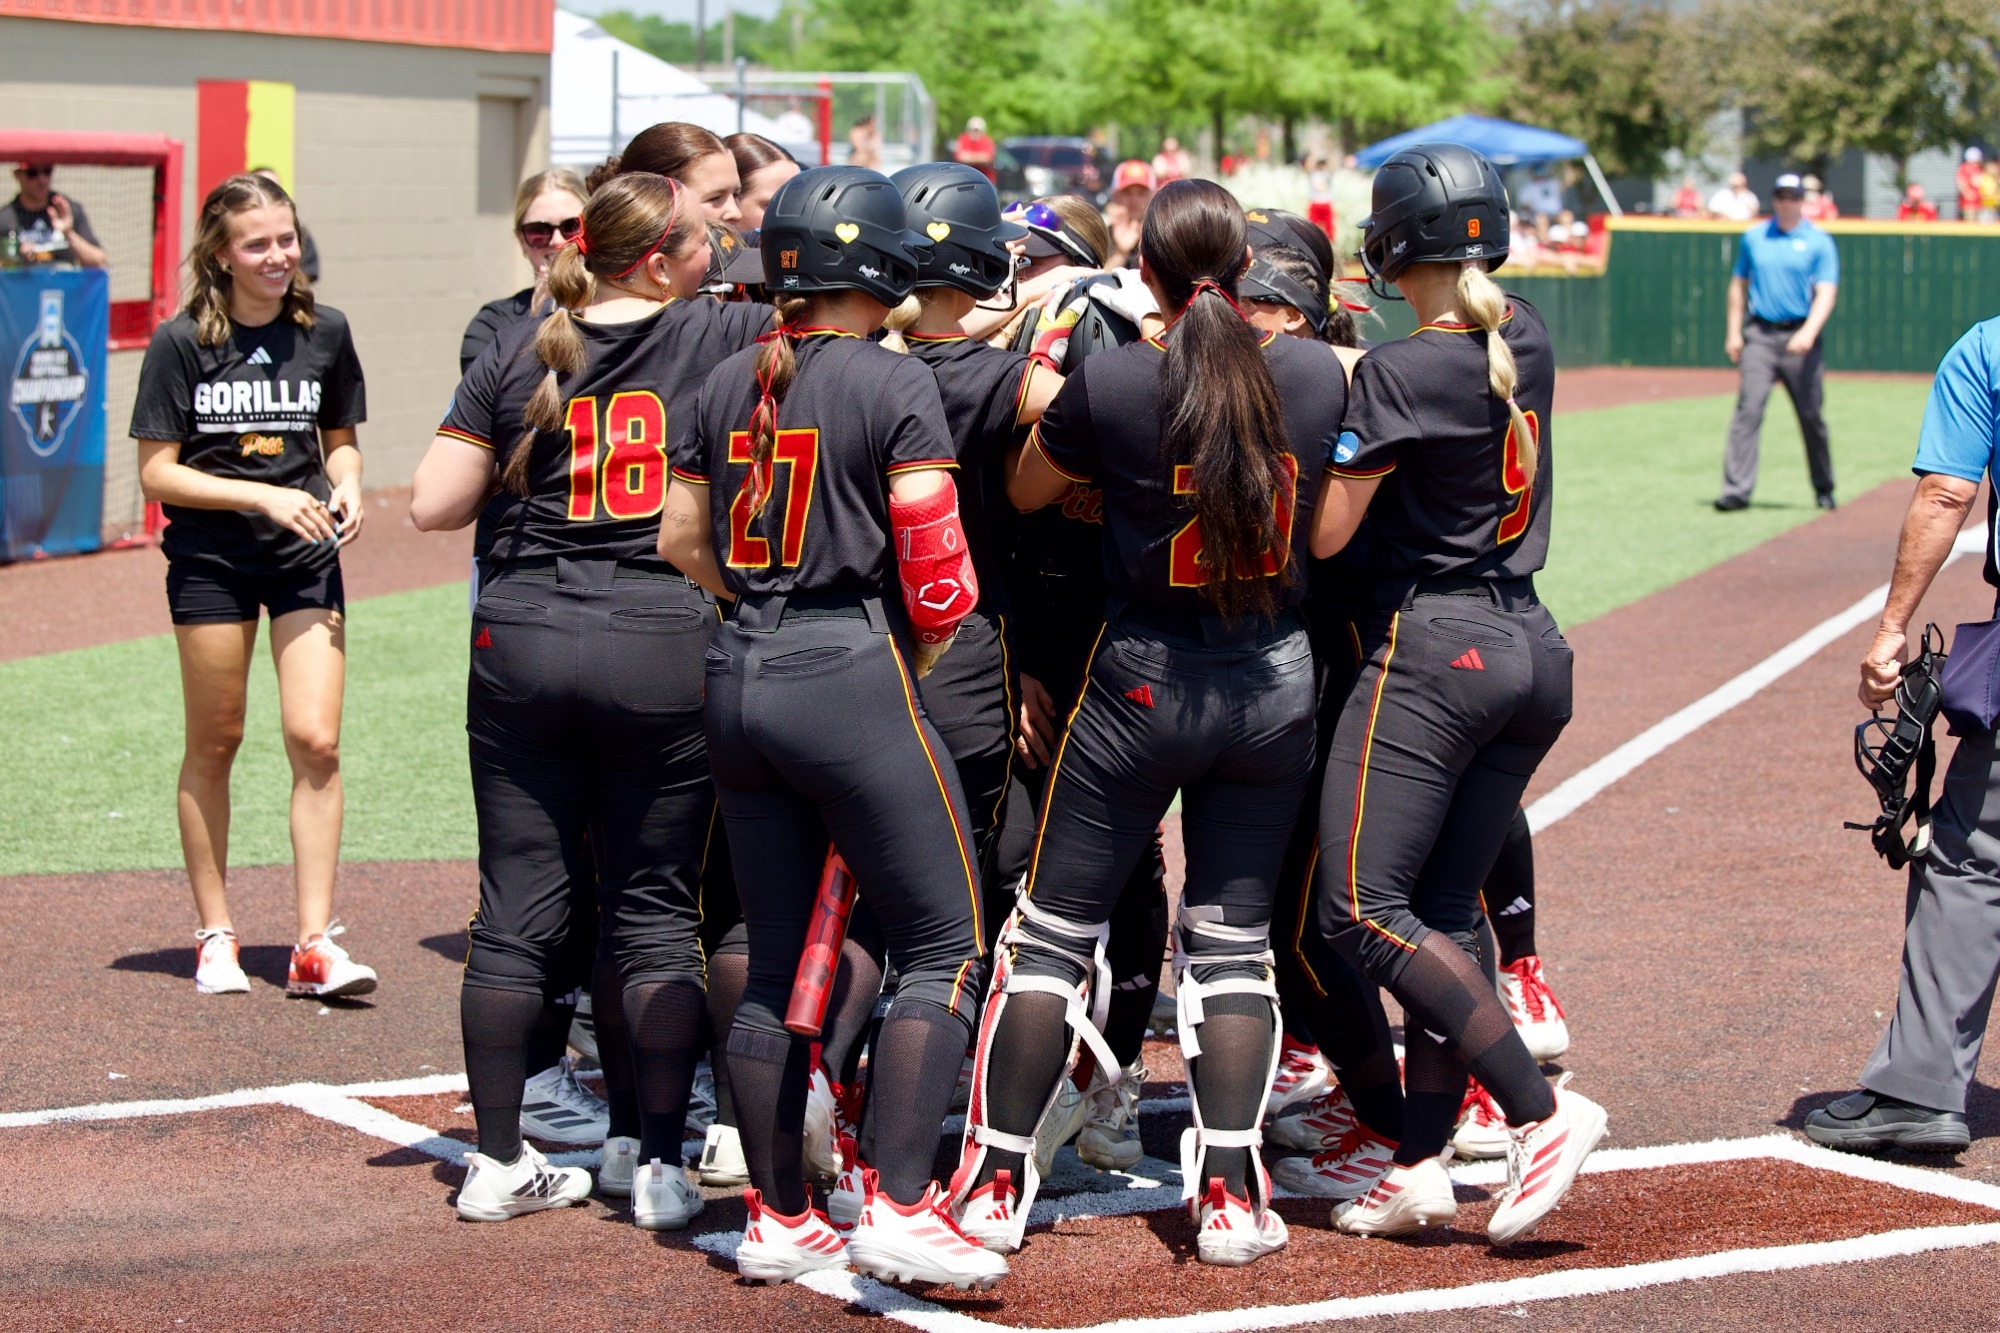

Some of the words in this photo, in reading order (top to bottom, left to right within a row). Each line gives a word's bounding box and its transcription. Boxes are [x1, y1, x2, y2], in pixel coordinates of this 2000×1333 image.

[1467, 218, 1481, 238] 9
[780, 250, 798, 269] 27
[194, 379, 322, 415] GORILLAS
[239, 432, 285, 457] Pitt
[564, 390, 668, 521] 18
[1497, 410, 1539, 545] 9
[726, 428, 818, 567] 27
